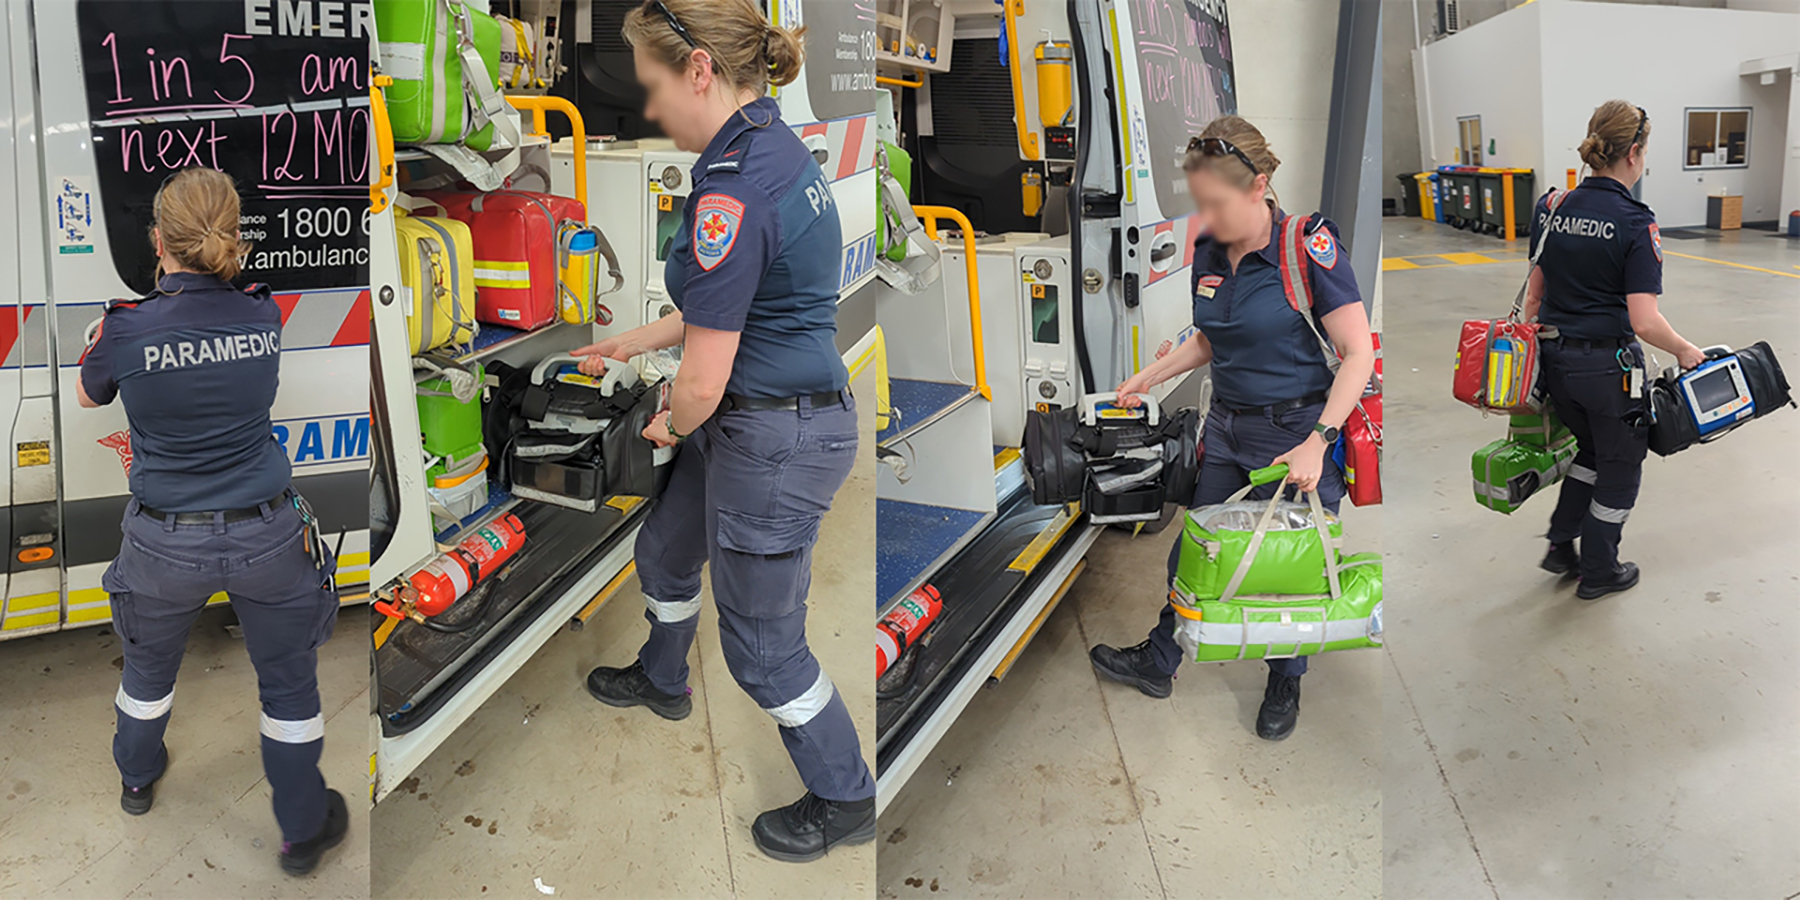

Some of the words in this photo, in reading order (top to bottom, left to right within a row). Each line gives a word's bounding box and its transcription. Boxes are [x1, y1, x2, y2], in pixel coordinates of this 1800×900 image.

[102, 32, 132, 104] 1
[146, 47, 193, 101] in
[213, 33, 255, 104] 5
[301, 53, 370, 96] am
[1144, 59, 1177, 107] next
[121, 120, 228, 173] next
[262, 110, 304, 181] 12
[661, 197, 669, 208] P
[277, 206, 352, 238] 1800
[1539, 212, 1615, 240] PARAMEDIC
[1035, 287, 1043, 296] P
[143, 330, 279, 371] PARAMEDIC
